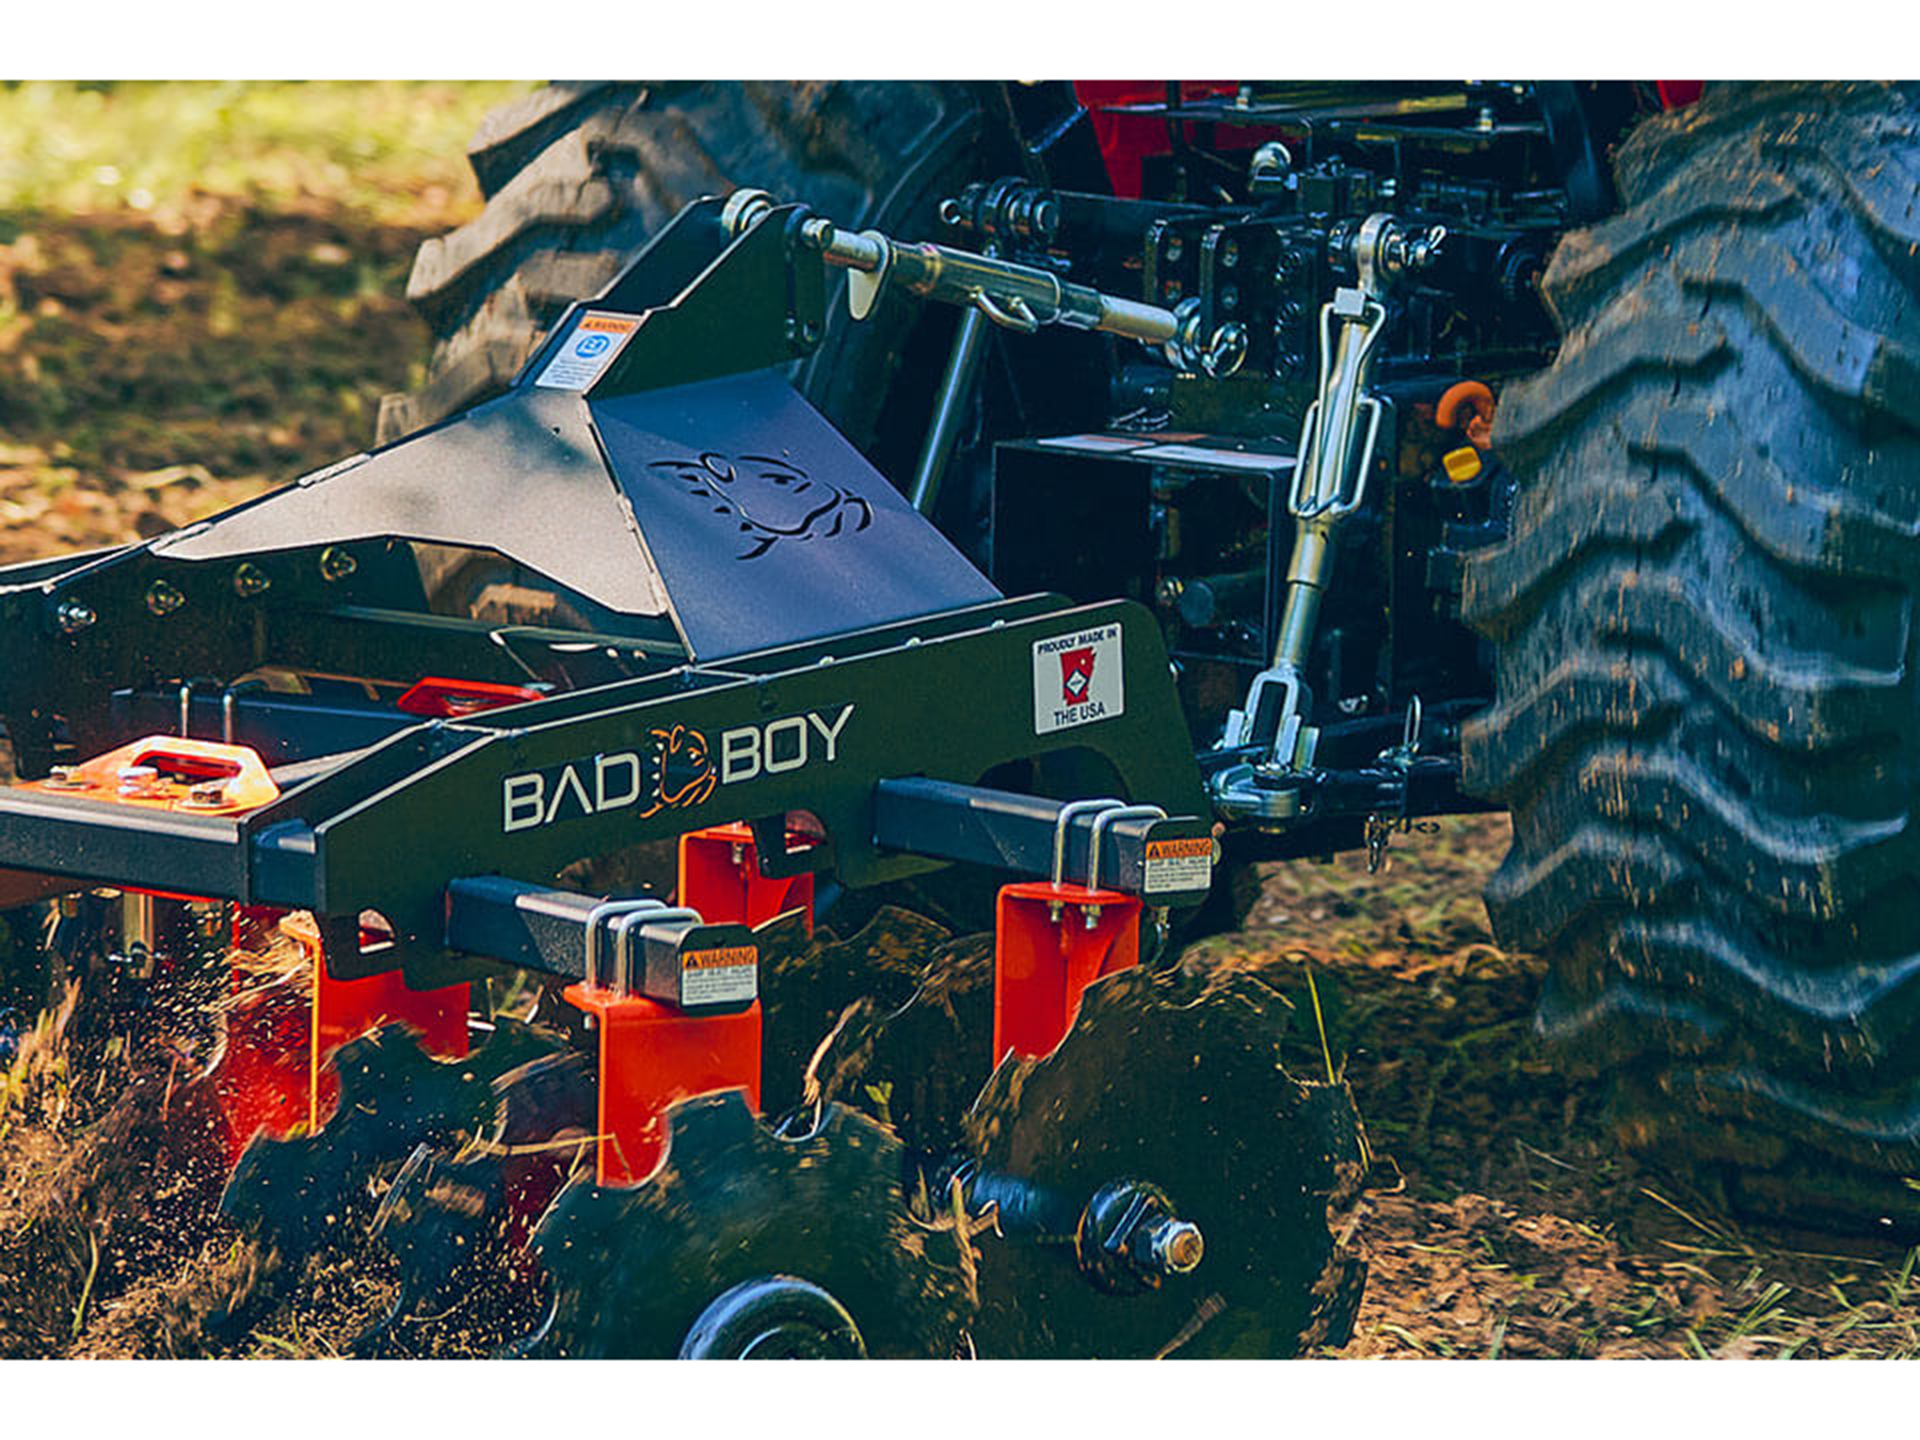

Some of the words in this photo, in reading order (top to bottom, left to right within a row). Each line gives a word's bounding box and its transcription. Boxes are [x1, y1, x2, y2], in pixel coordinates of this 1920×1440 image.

[1037, 638, 1076, 655] PROUDLY
[1078, 630, 1105, 645] MADE
[1107, 627, 1118, 639] IN
[1054, 707, 1078, 726] THE
[1079, 701, 1106, 720] USA
[503, 752, 641, 832] BAD
[721, 703, 855, 785] BOY
[1162, 840, 1210, 857] WARNING
[701, 948, 755, 966] WARNING
